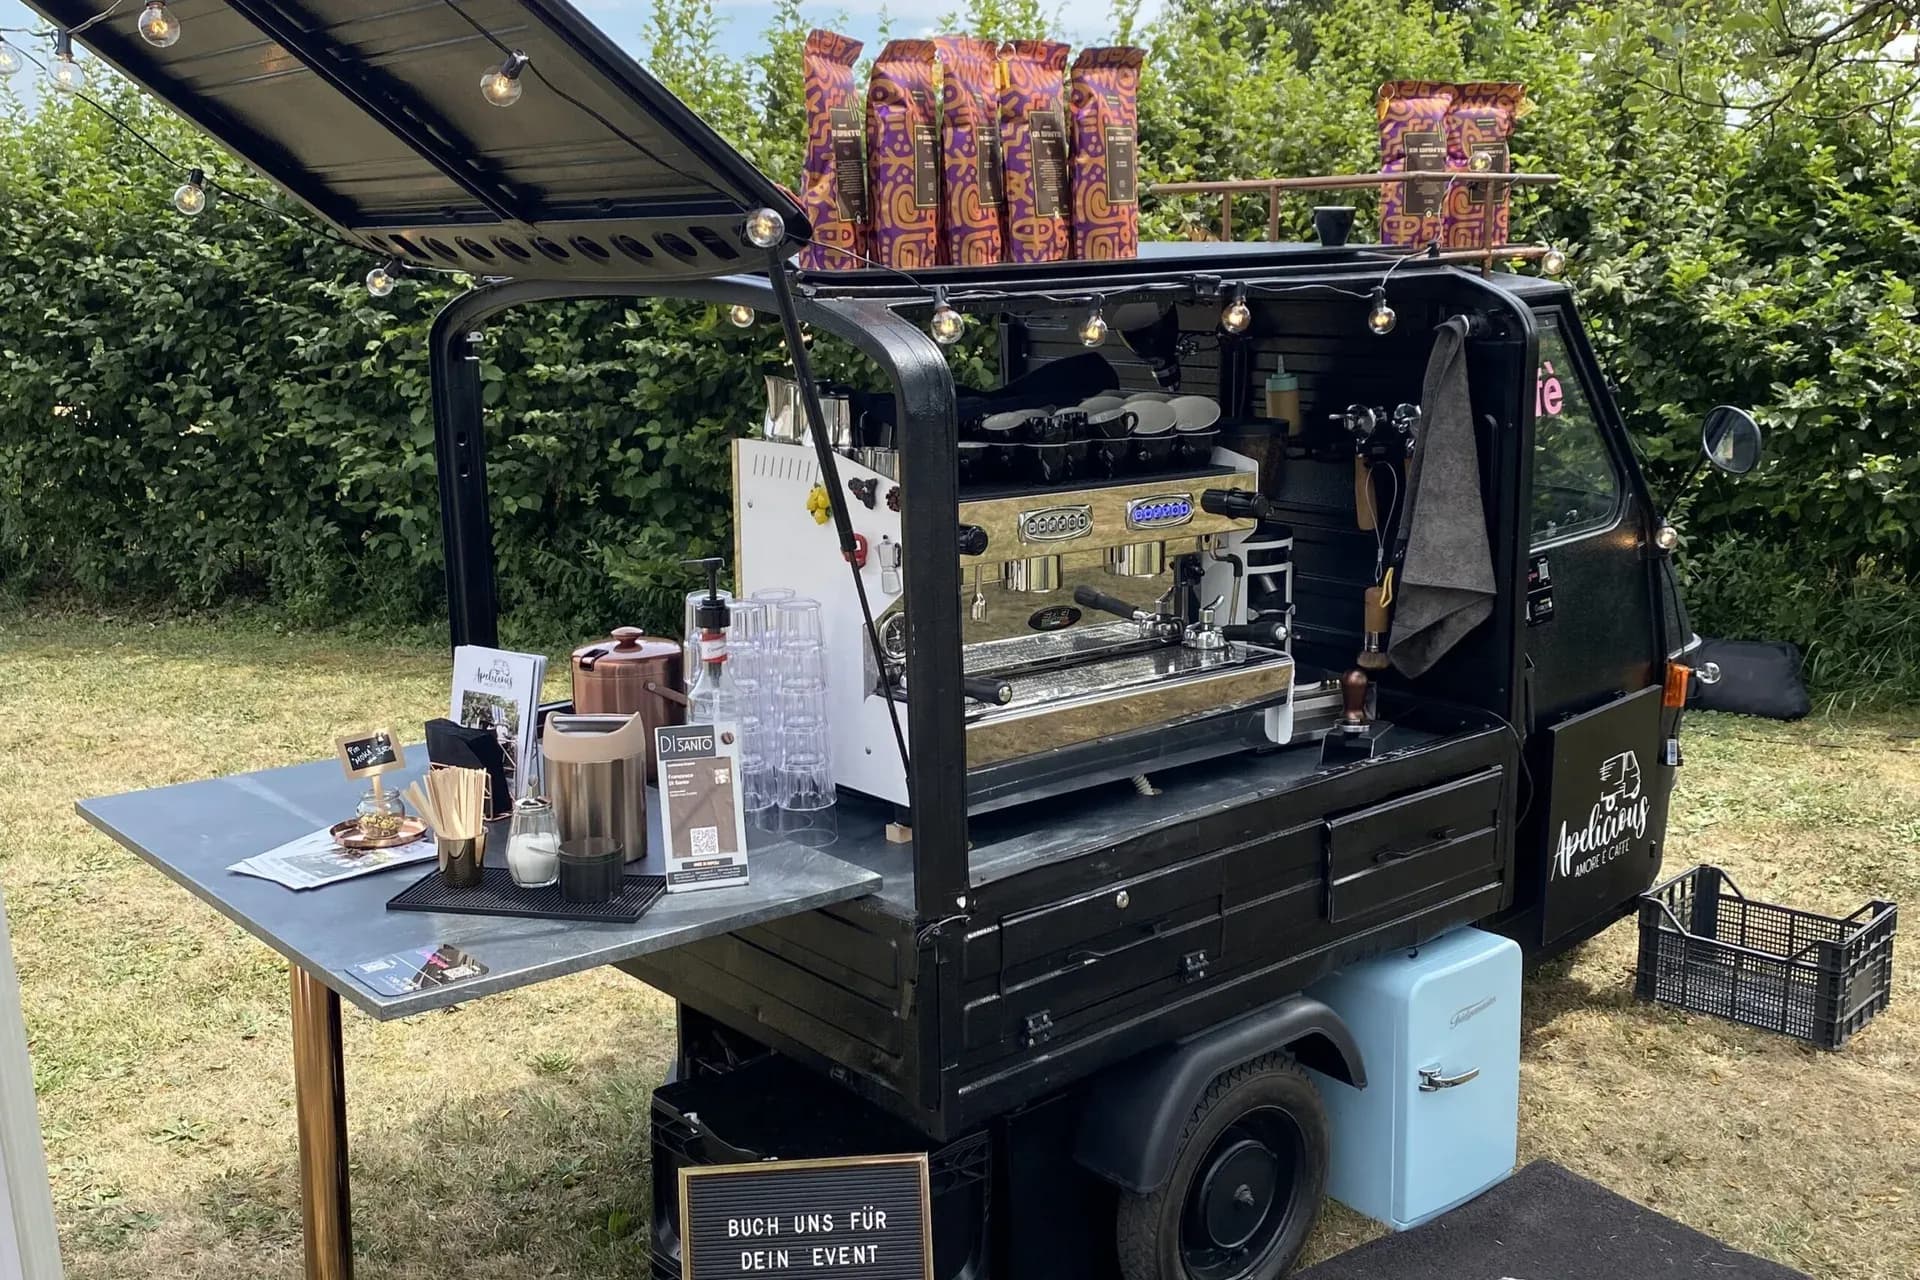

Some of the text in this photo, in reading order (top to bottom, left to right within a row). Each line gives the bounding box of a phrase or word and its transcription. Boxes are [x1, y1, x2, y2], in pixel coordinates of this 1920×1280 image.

[676, 735, 713, 752] SANTO
[1550, 795, 1651, 882] Apelicious
[1574, 853, 1601, 878] AMORE
[728, 1205, 887, 1238] BUCH UNS FÜR
[741, 1244, 878, 1271] DEIN EVENT
